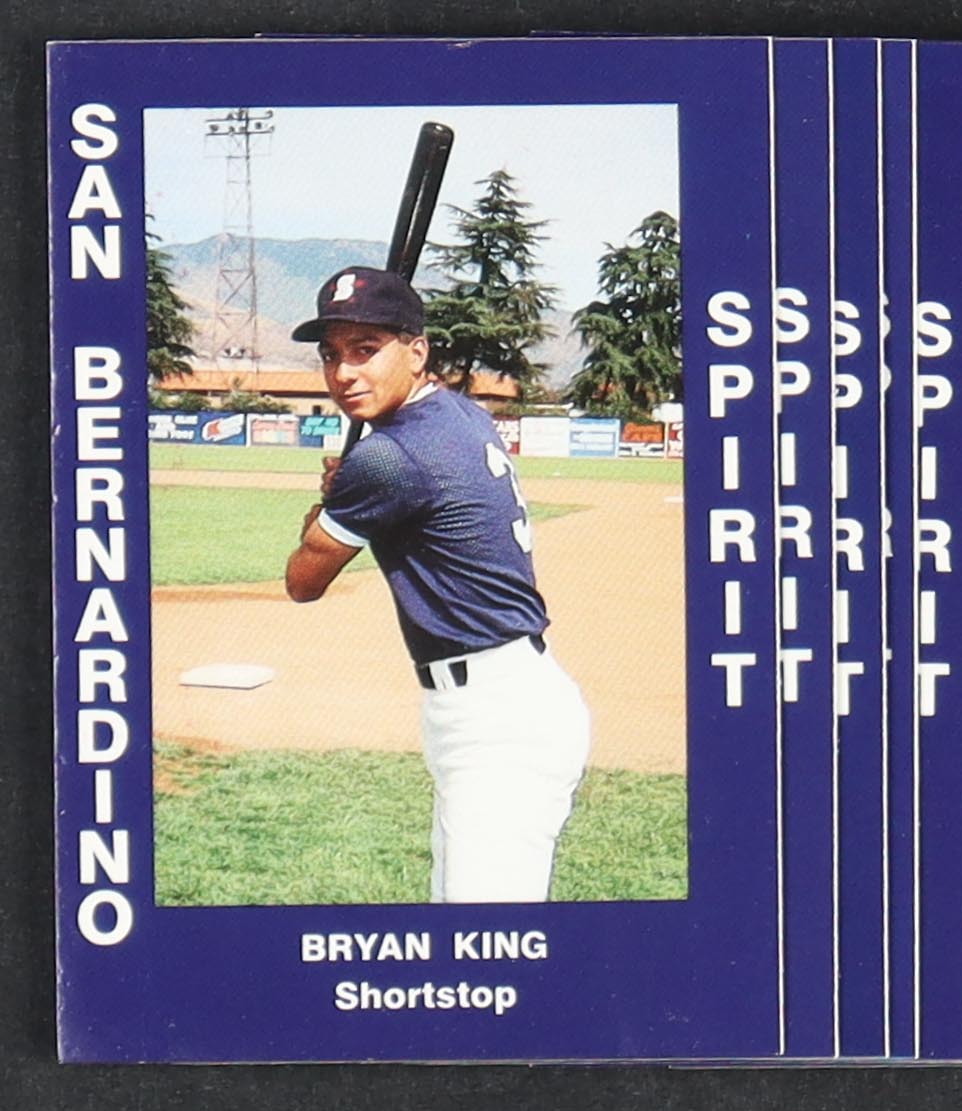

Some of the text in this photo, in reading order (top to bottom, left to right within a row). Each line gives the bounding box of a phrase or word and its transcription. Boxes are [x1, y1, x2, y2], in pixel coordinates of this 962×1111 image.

[68, 103, 133, 946] SAN BERNARDINO
[707, 291, 757, 707] SPIRIT
[775, 287, 814, 702] SPIRIT
[917, 301, 953, 716] SPIRIT
[301, 930, 548, 962] BRYAN KING
[335, 981, 517, 1015] Shortstop
